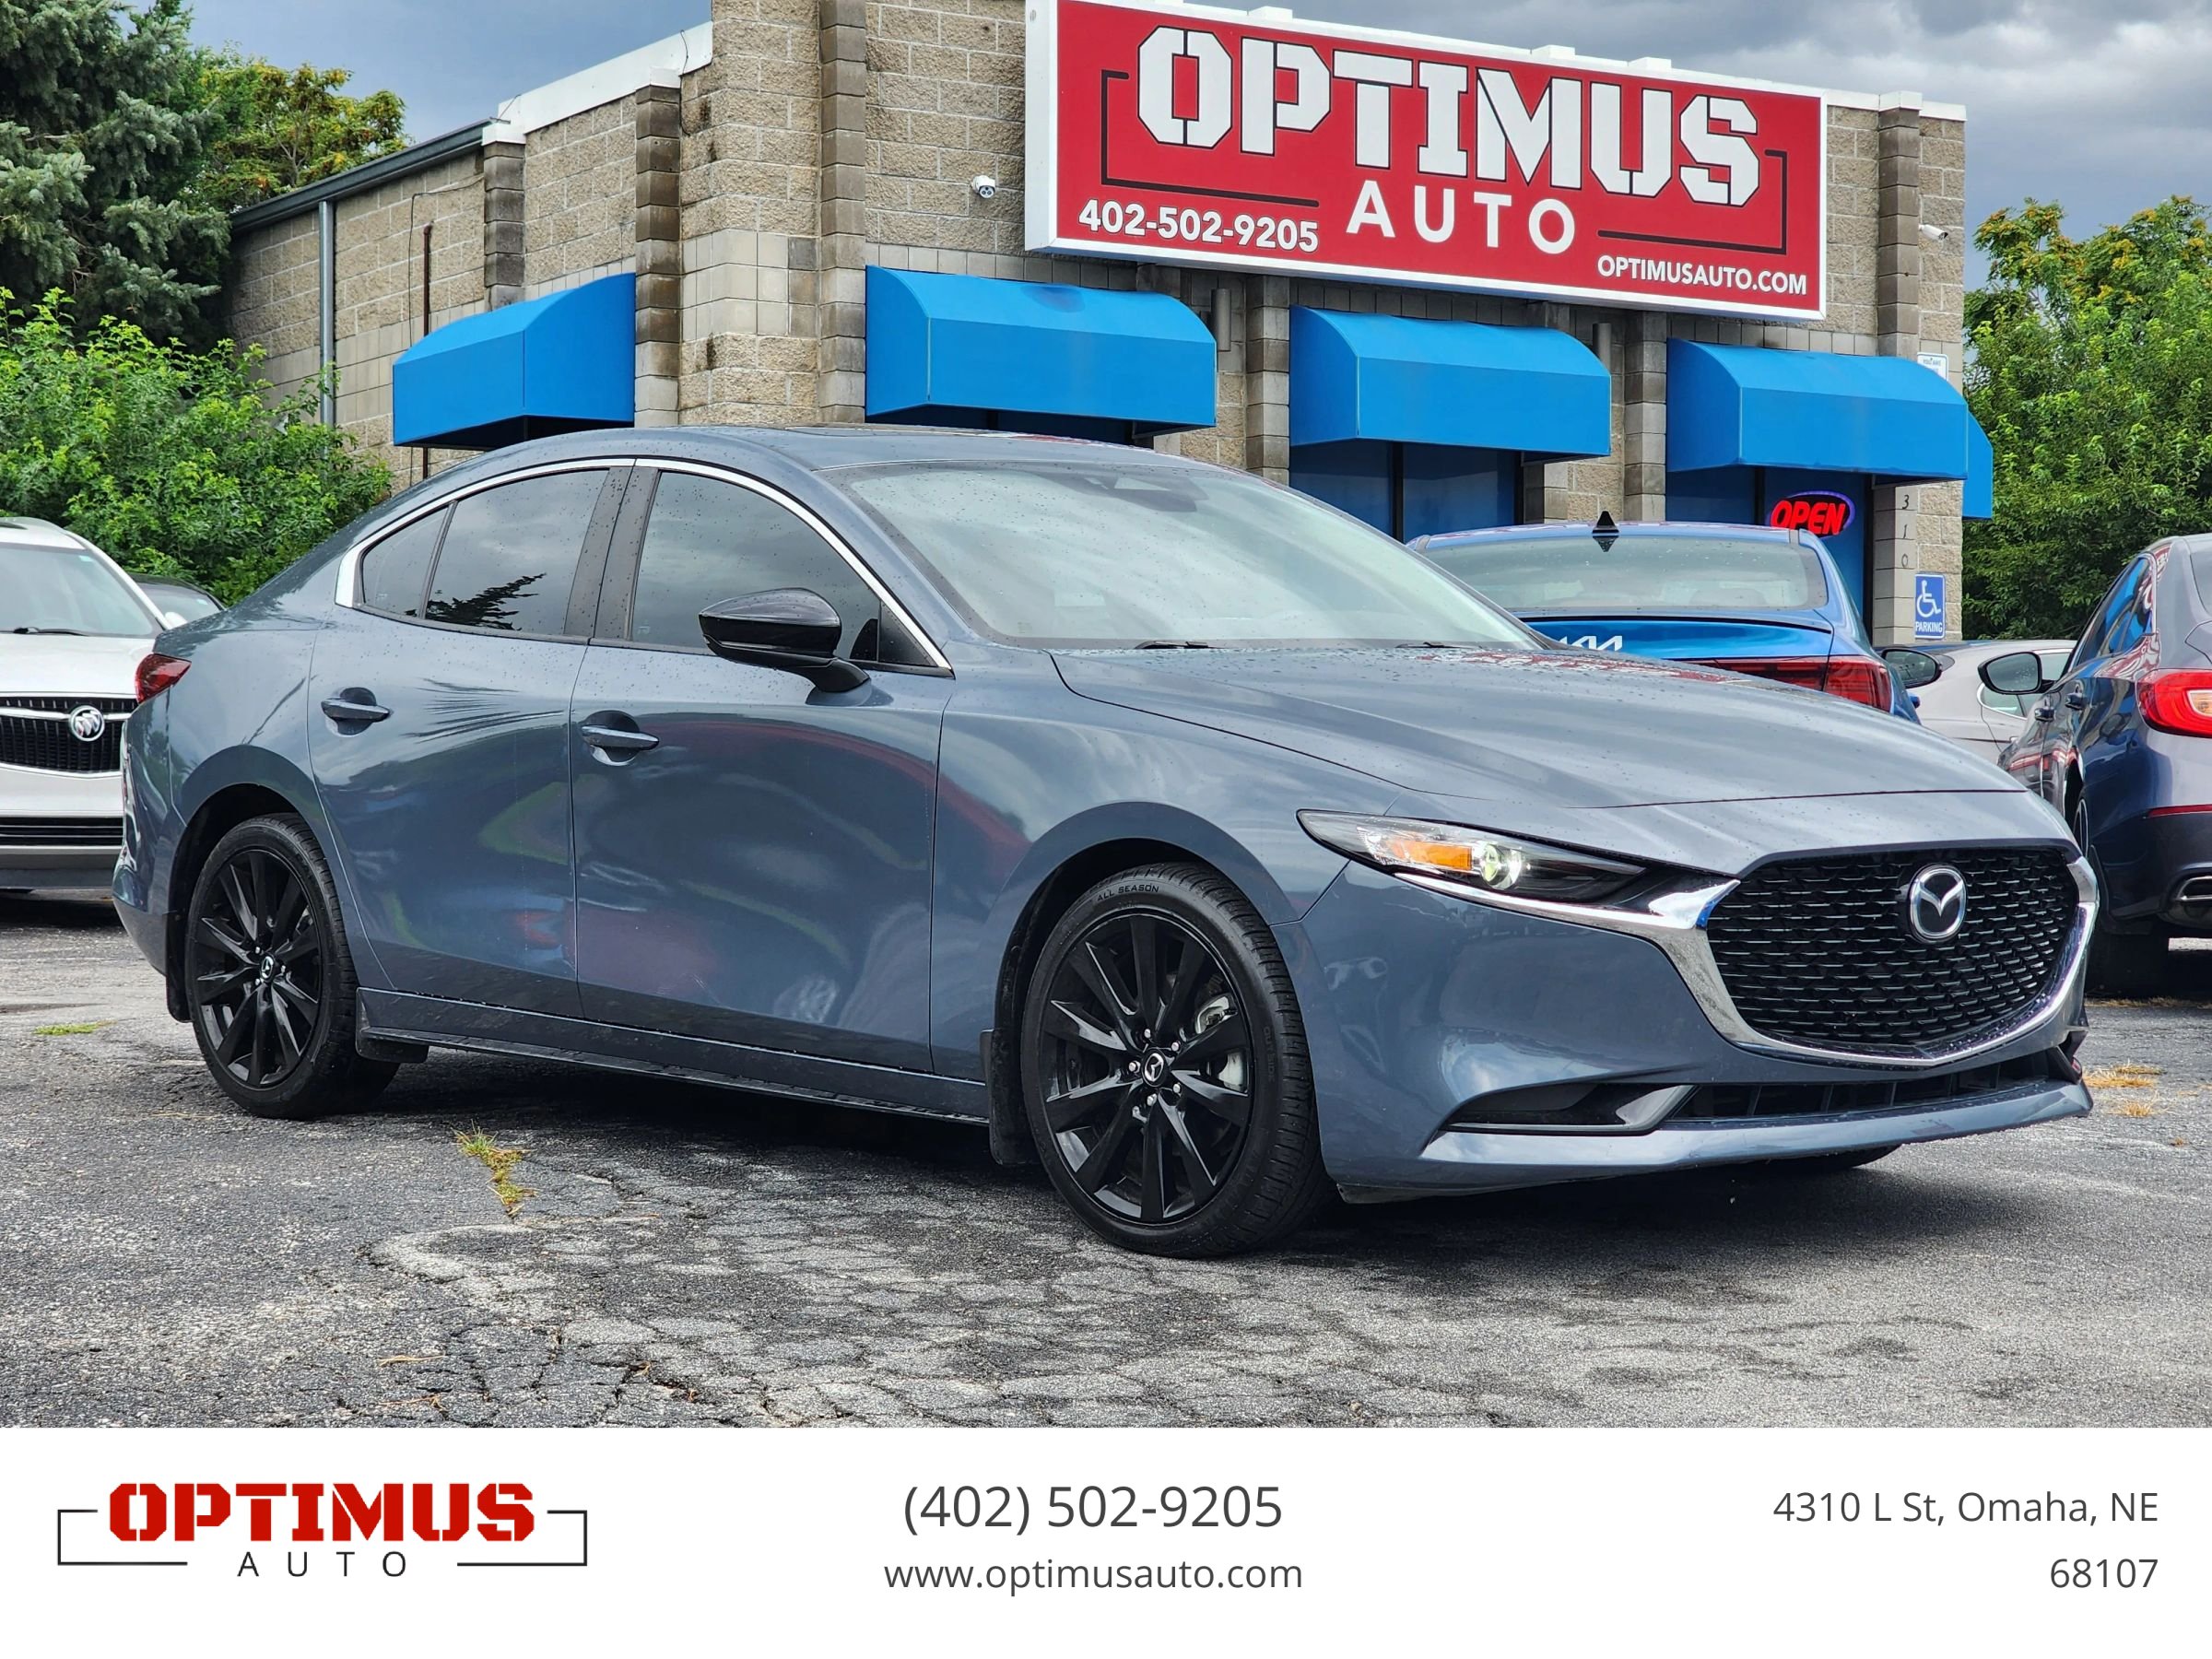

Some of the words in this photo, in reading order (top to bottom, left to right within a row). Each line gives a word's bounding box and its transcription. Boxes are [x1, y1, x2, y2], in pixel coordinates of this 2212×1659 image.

[1136, 25, 1760, 207] OPTIMUS
[1078, 199, 1319, 253] 402-502-9205
[1346, 180, 1575, 254] AUTO
[1597, 254, 1807, 295] OPTIMUSAUTO.COM
[1771, 500, 1846, 535] OPEN
[1915, 621, 1943, 633] PARKING
[1097, 889, 1115, 901] ALL
[1118, 884, 1159, 894] SEASON
